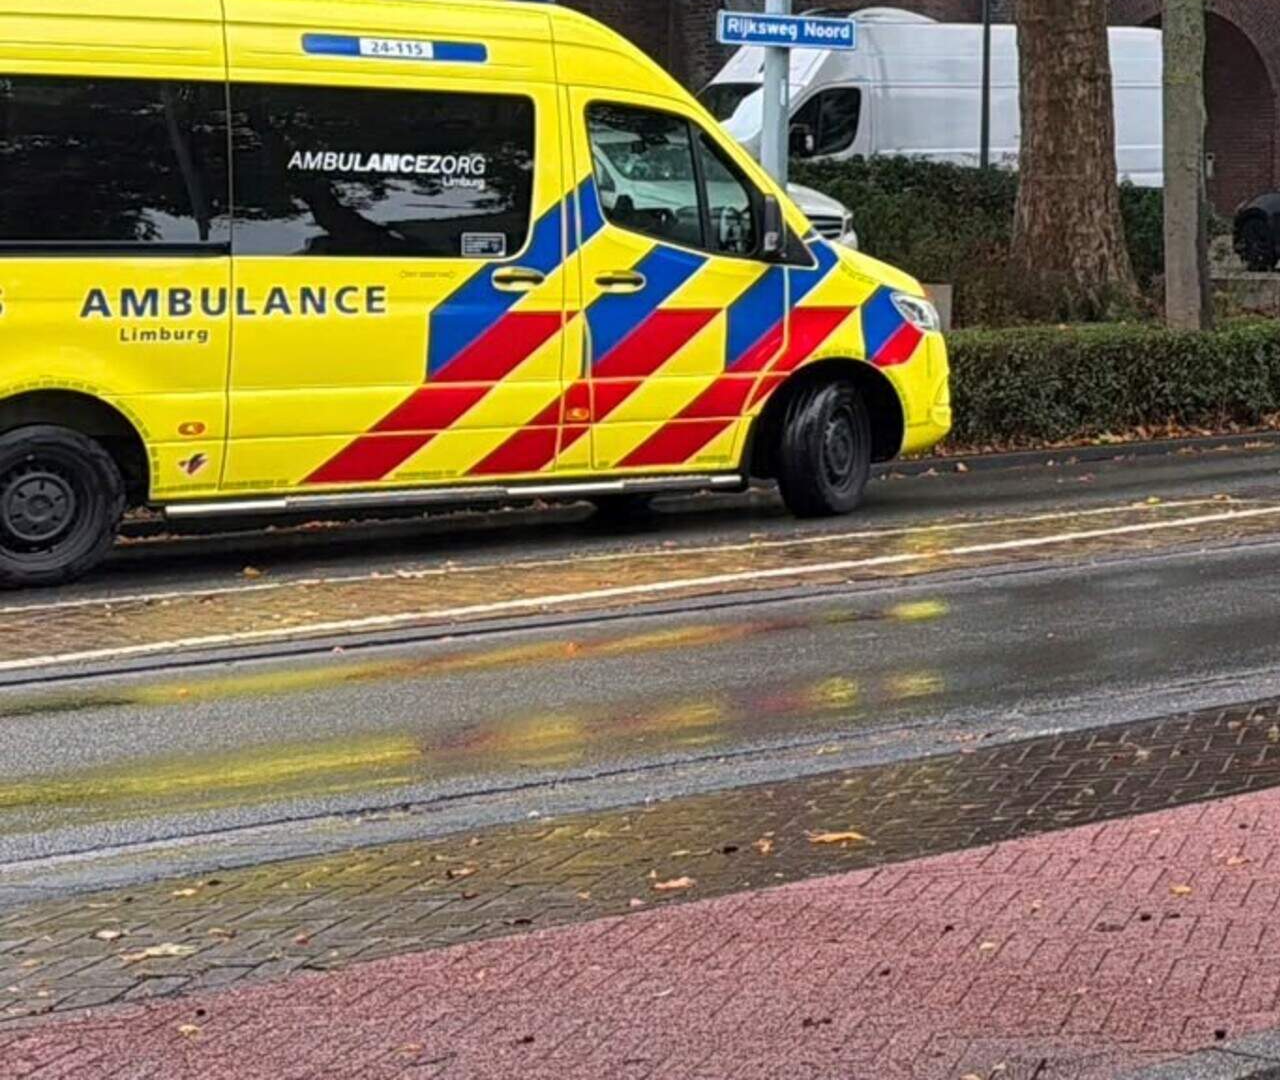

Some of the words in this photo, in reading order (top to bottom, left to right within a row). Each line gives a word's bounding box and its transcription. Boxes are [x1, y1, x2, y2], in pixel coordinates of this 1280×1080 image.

[727, 18, 797, 40] Rijksweg
[804, 22, 850, 39] Noord
[371, 41, 423, 55] 24-115
[288, 151, 486, 174] AMBULANCEZORG
[442, 176, 485, 190] Limburg
[80, 286, 387, 317] AMBULANCE
[120, 328, 208, 343] Limburg
